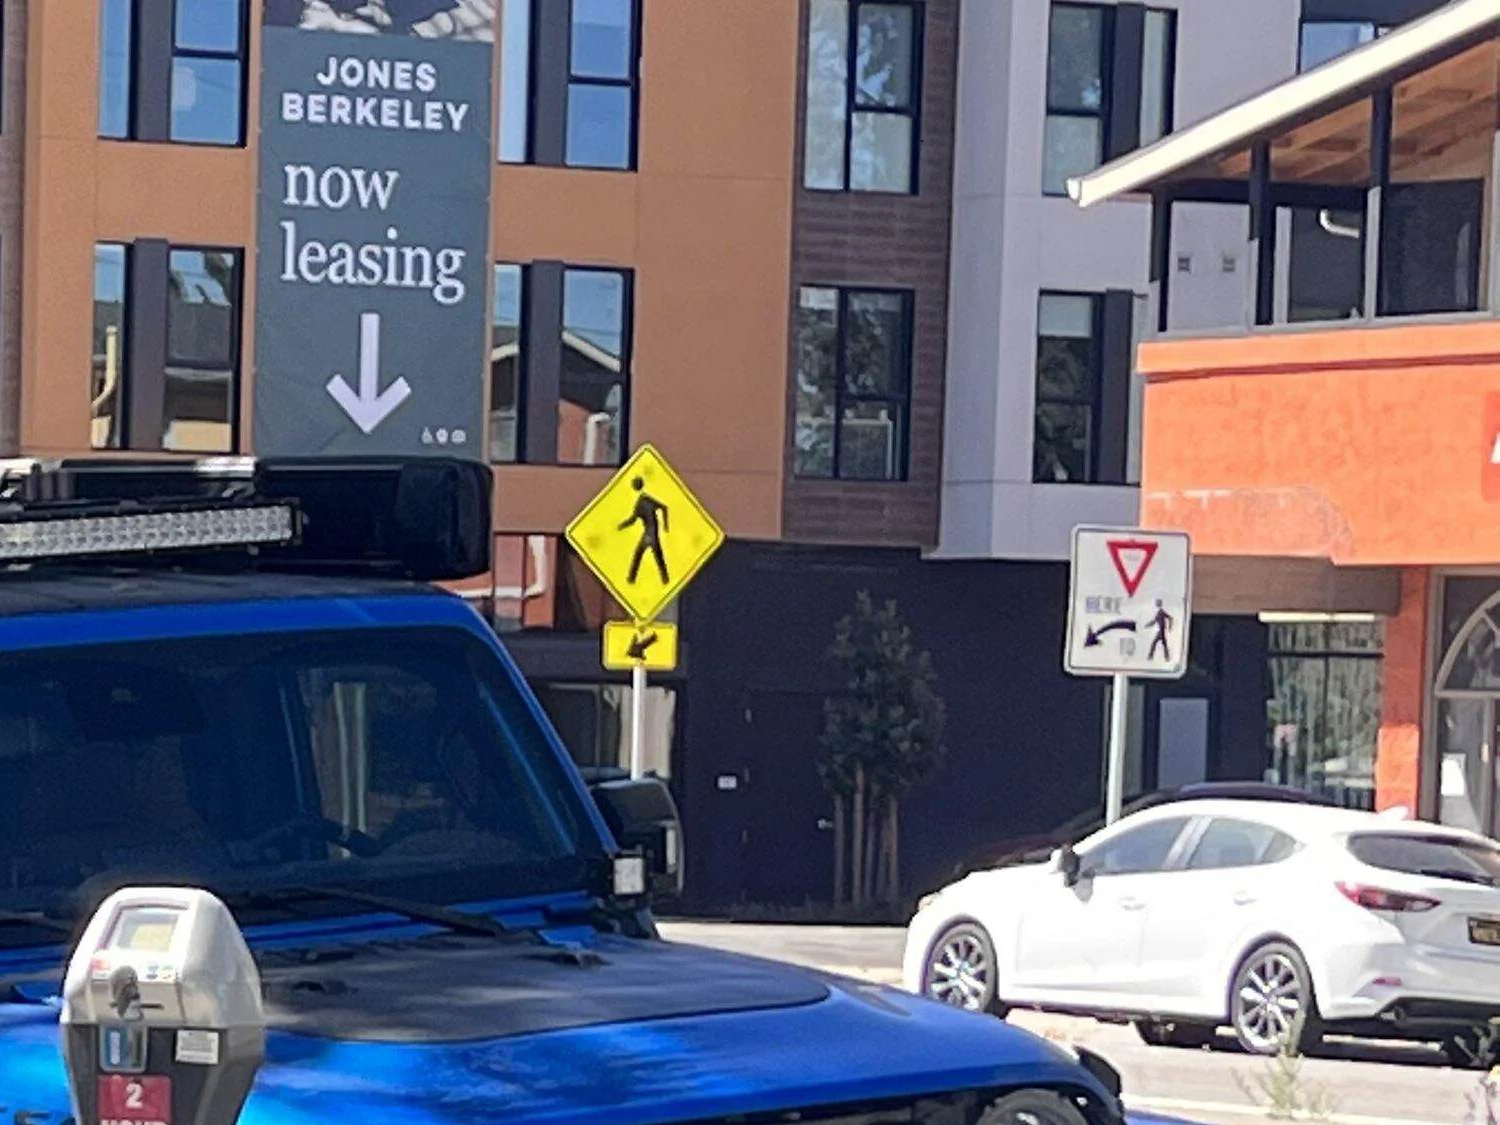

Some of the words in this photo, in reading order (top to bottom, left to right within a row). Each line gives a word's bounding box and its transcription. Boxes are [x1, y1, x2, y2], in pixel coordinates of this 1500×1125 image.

[315, 56, 437, 92] JONES
[281, 93, 469, 131] BERKELEY
[283, 164, 399, 210] now
[280, 220, 466, 304] leasing
[125, 1083, 144, 1109] 2
